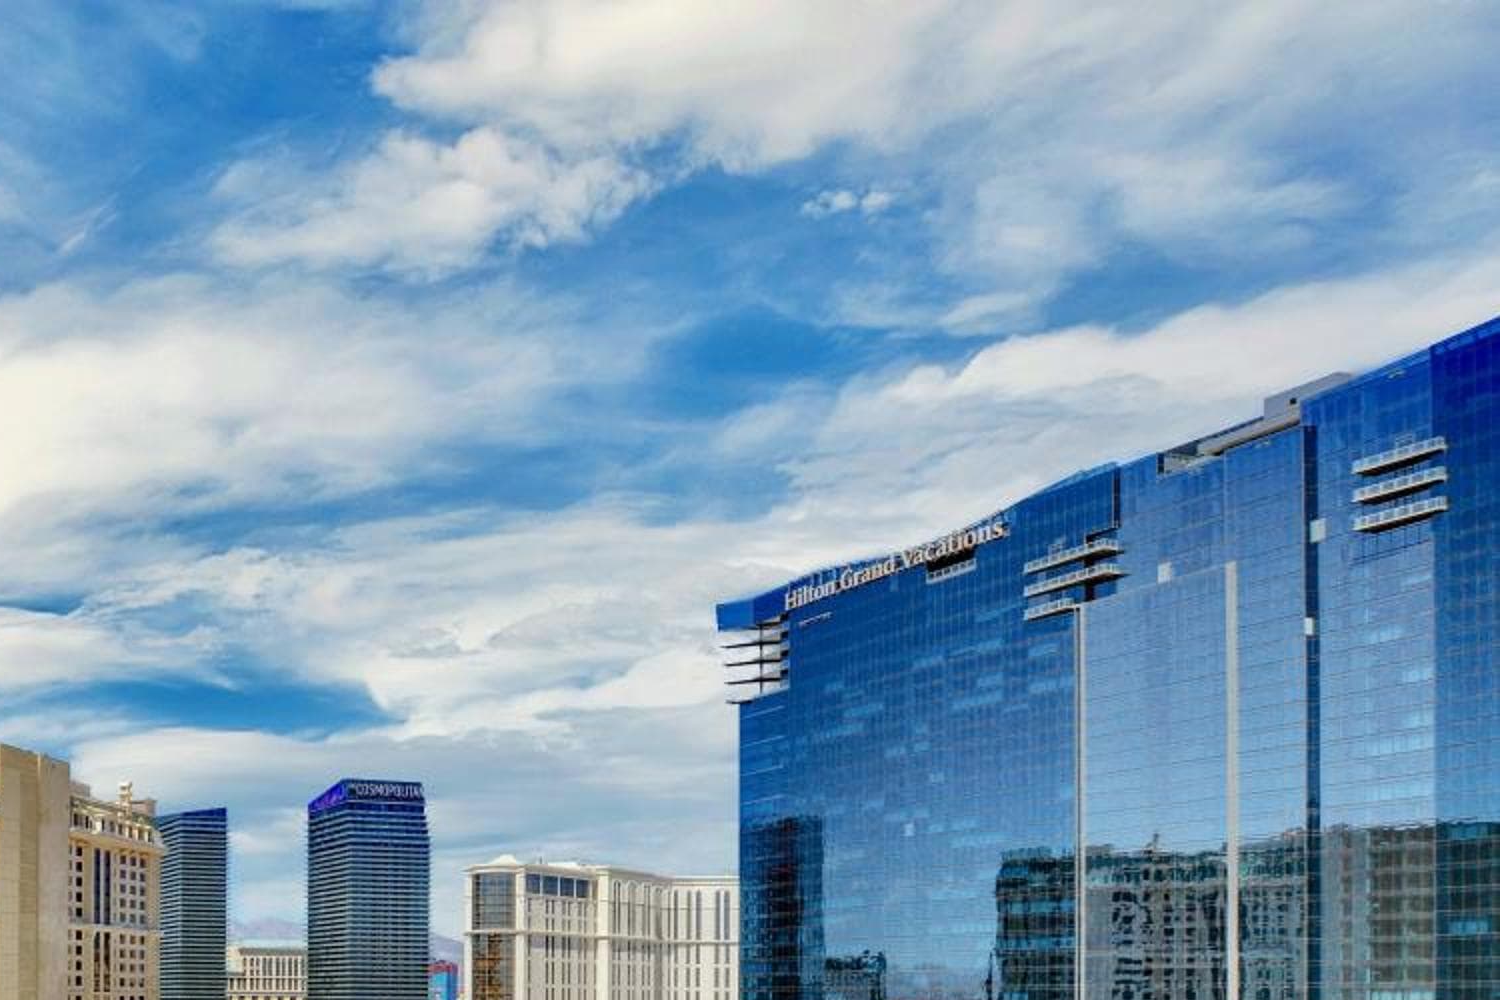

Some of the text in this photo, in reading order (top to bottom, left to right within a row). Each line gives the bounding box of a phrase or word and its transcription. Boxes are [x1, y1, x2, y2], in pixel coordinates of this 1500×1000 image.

[784, 520, 1005, 611] Hilton Grand Vacations
